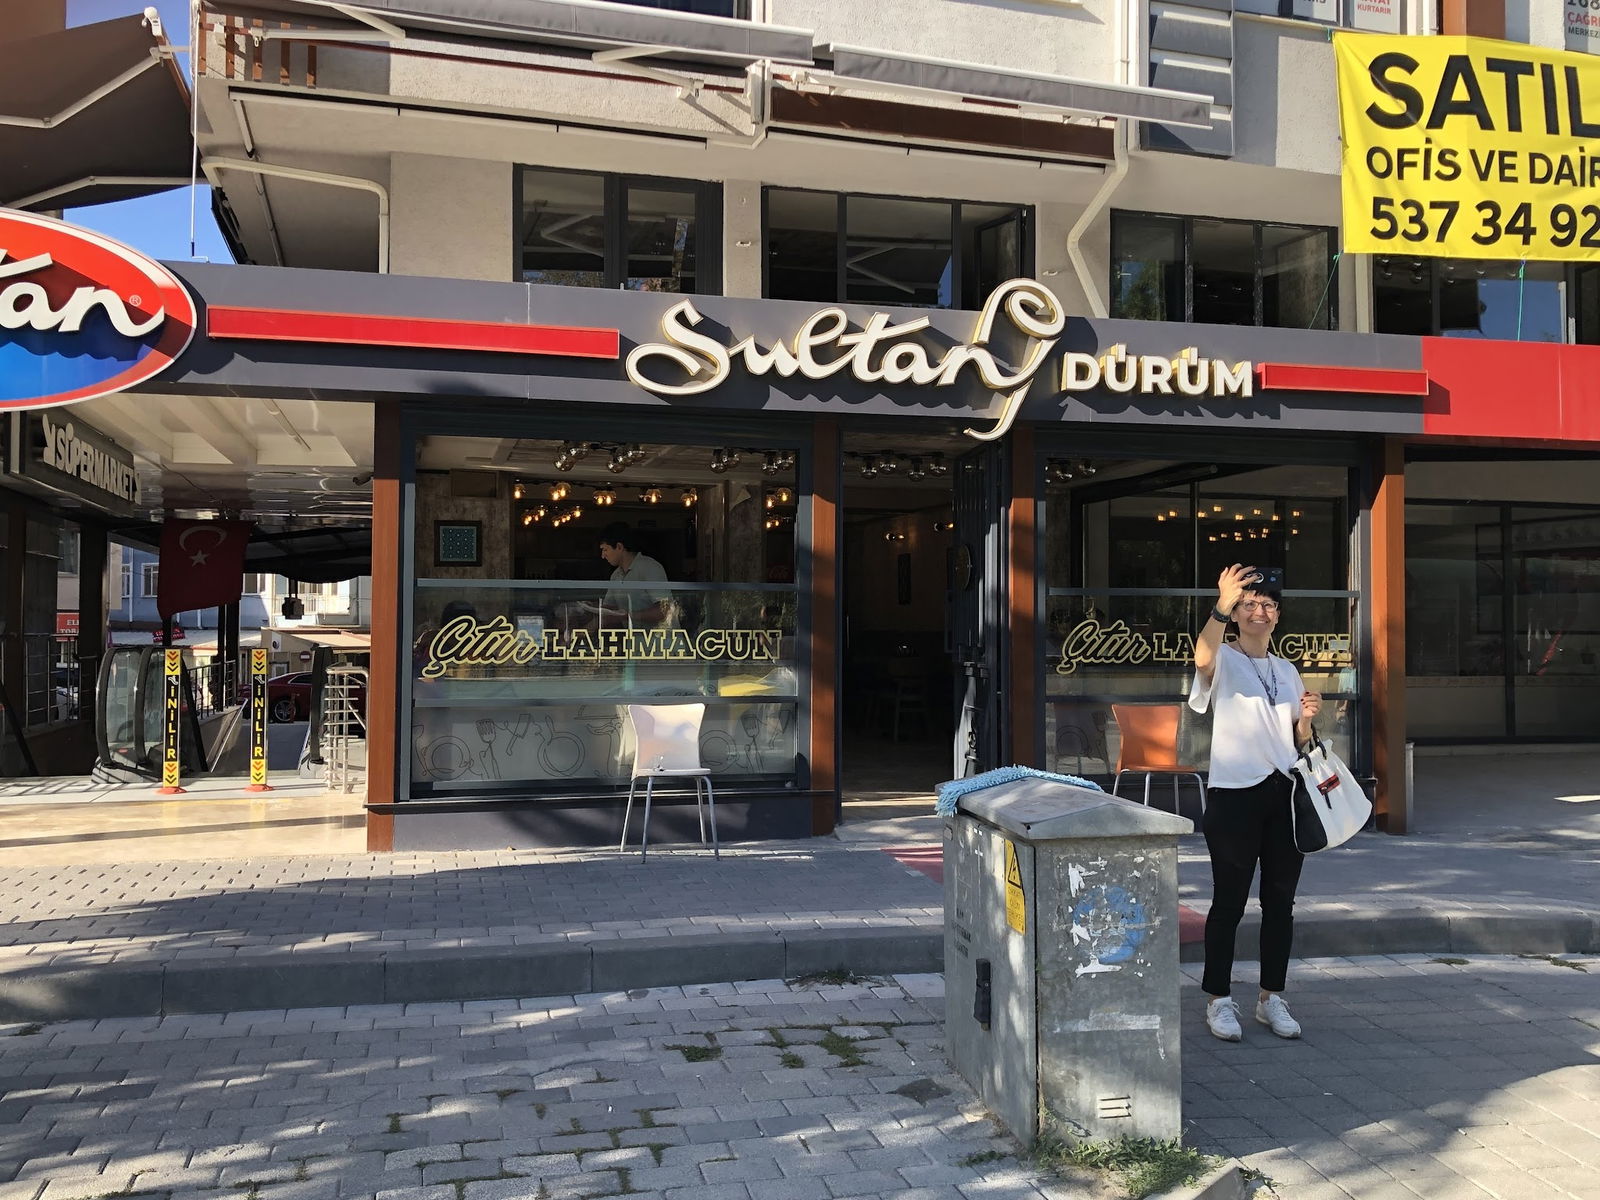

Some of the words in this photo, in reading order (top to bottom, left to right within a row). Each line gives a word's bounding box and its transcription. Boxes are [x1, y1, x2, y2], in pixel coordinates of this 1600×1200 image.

[1365, 52, 1600, 138] SATIL
[1366, 137, 1462, 181] OFİS
[1469, 148, 1519, 183] VE
[1370, 196, 1460, 242] 537
[1471, 200, 1537, 246] 34
[1550, 203, 1600, 248] 92
[626, 277, 1064, 442] Sultan
[1061, 343, 1254, 397] DÜRÜM
[55, 423, 134, 501] SÜPERMARKET
[541, 629, 783, 660] LAHMACUN
